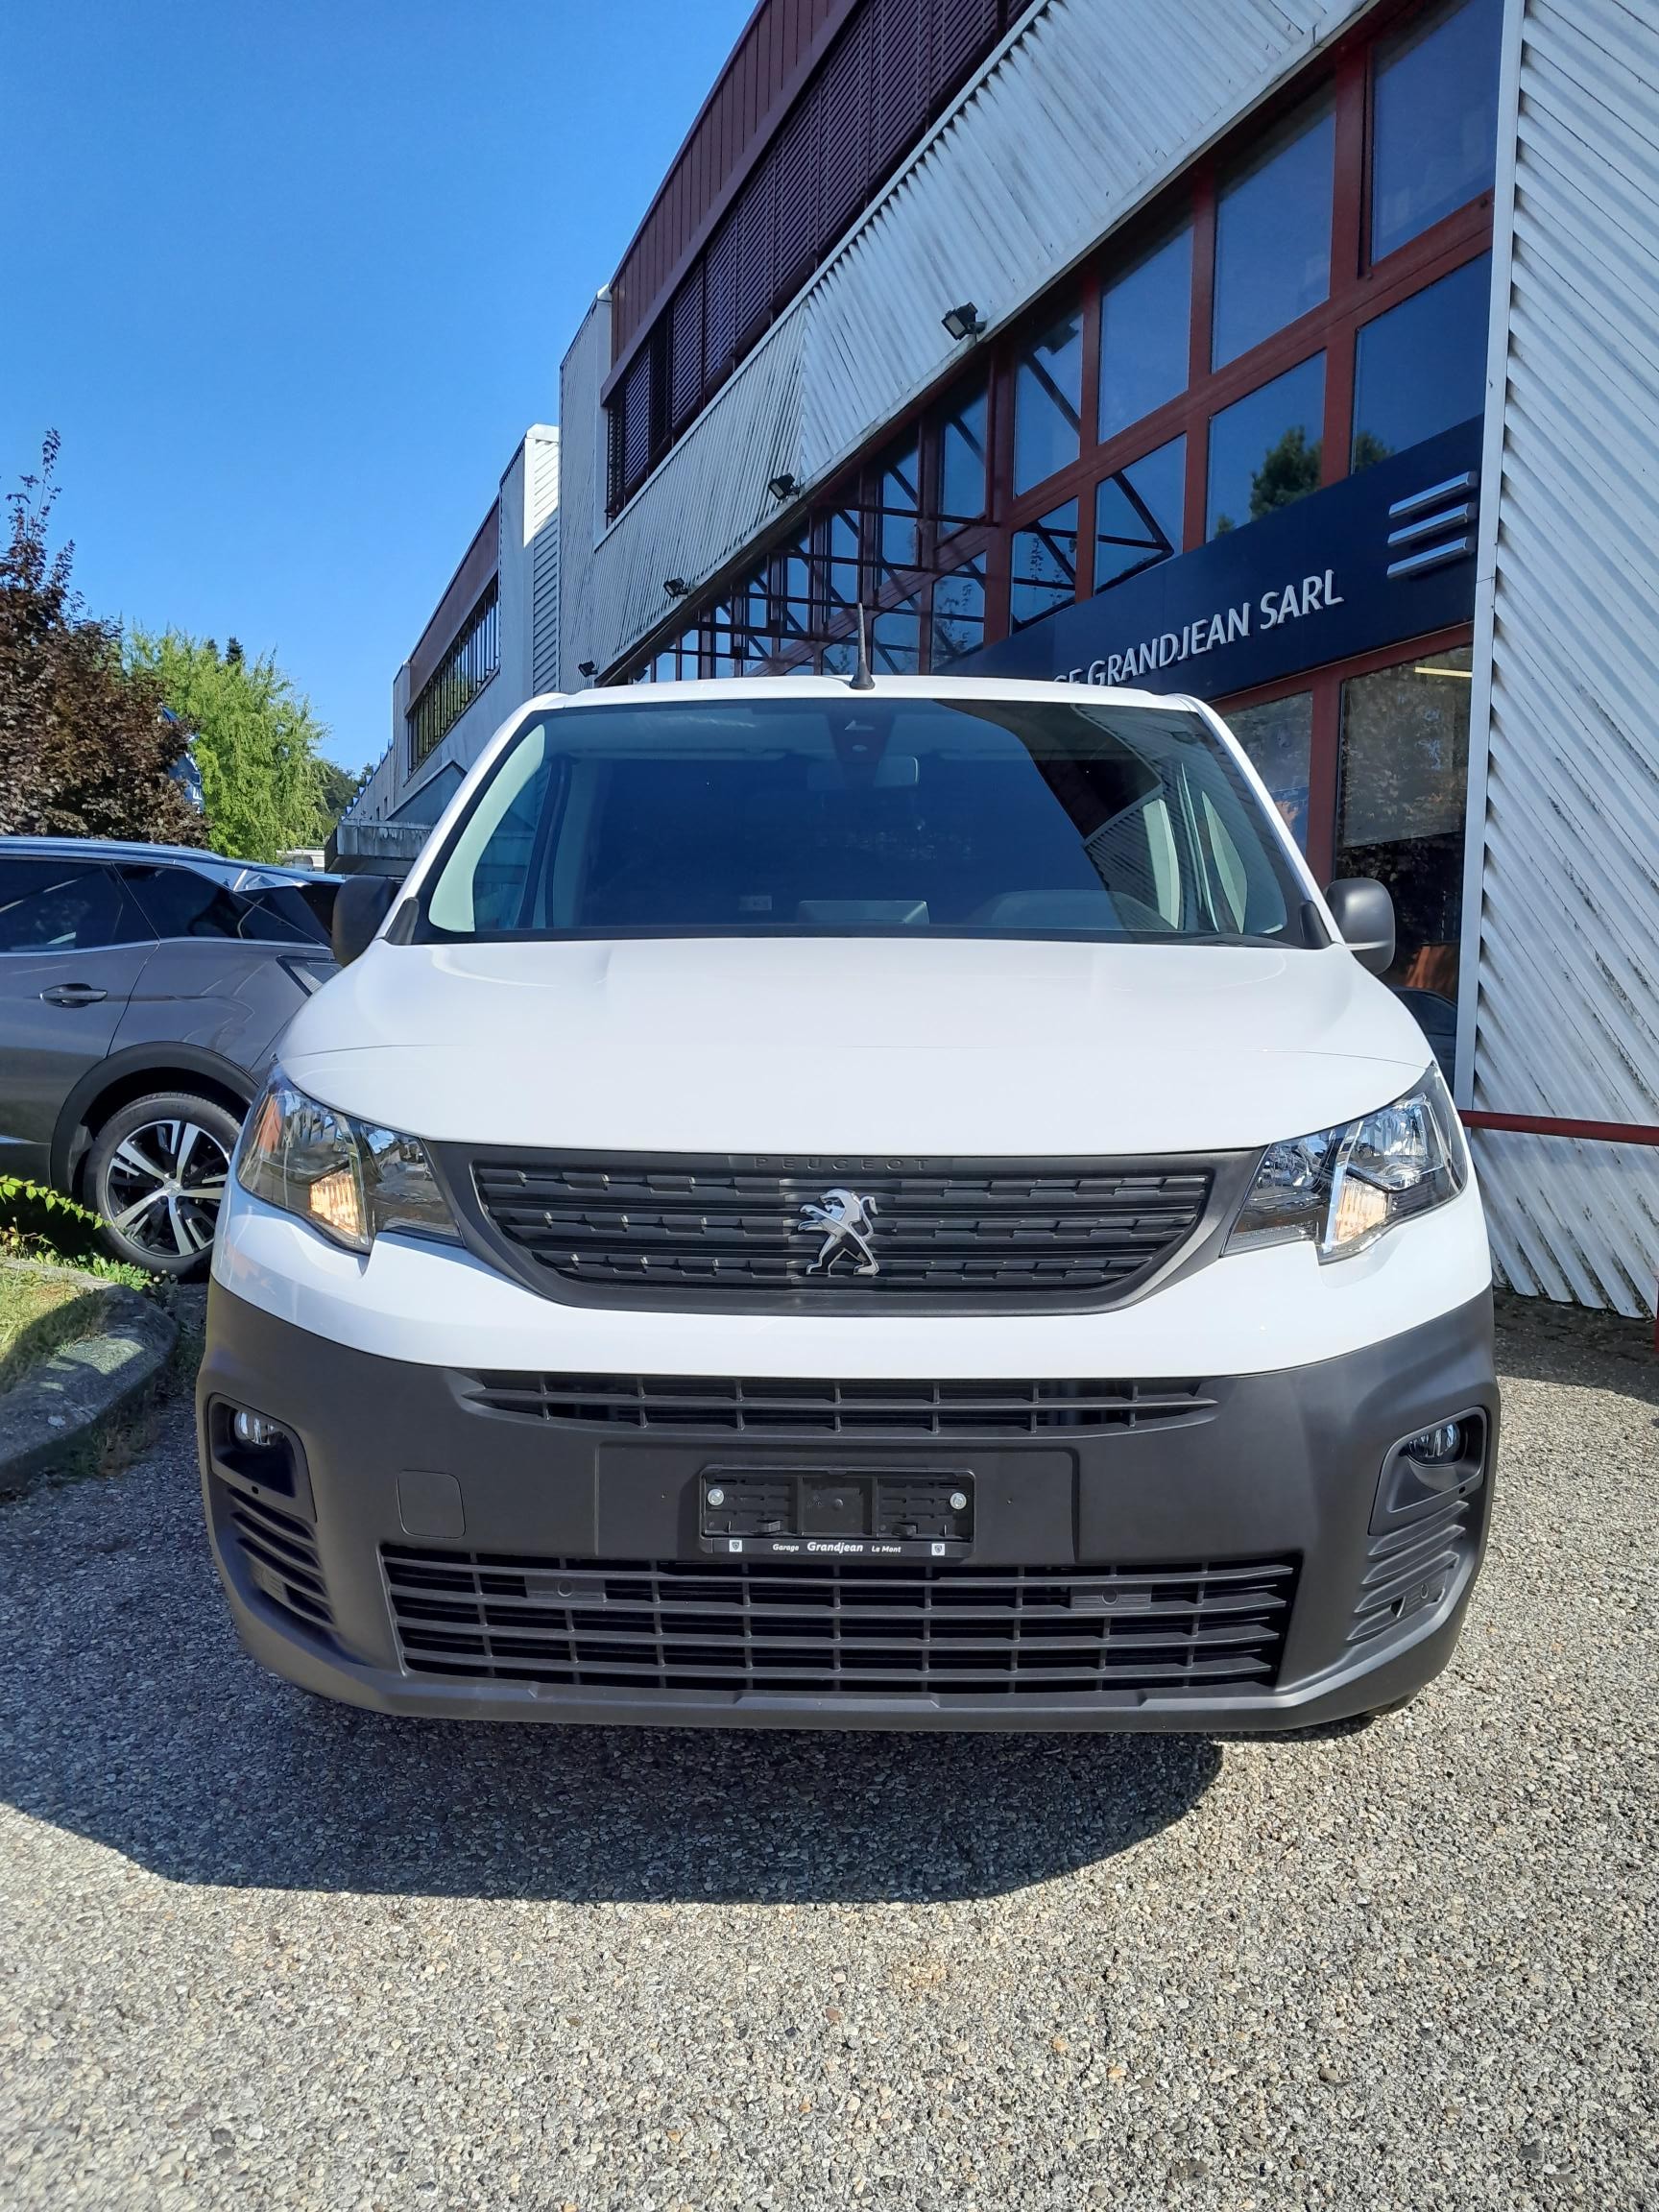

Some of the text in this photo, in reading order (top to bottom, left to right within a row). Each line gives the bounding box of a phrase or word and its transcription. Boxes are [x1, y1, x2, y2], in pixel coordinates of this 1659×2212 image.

[1087, 569, 1344, 685] GRANDJEAN SARL
[754, 1157, 929, 1171] PEUGEOT
[772, 1543, 800, 1552] Garage
[806, 1541, 864, 1554] Grandjean
[881, 1545, 902, 1553] Mont
